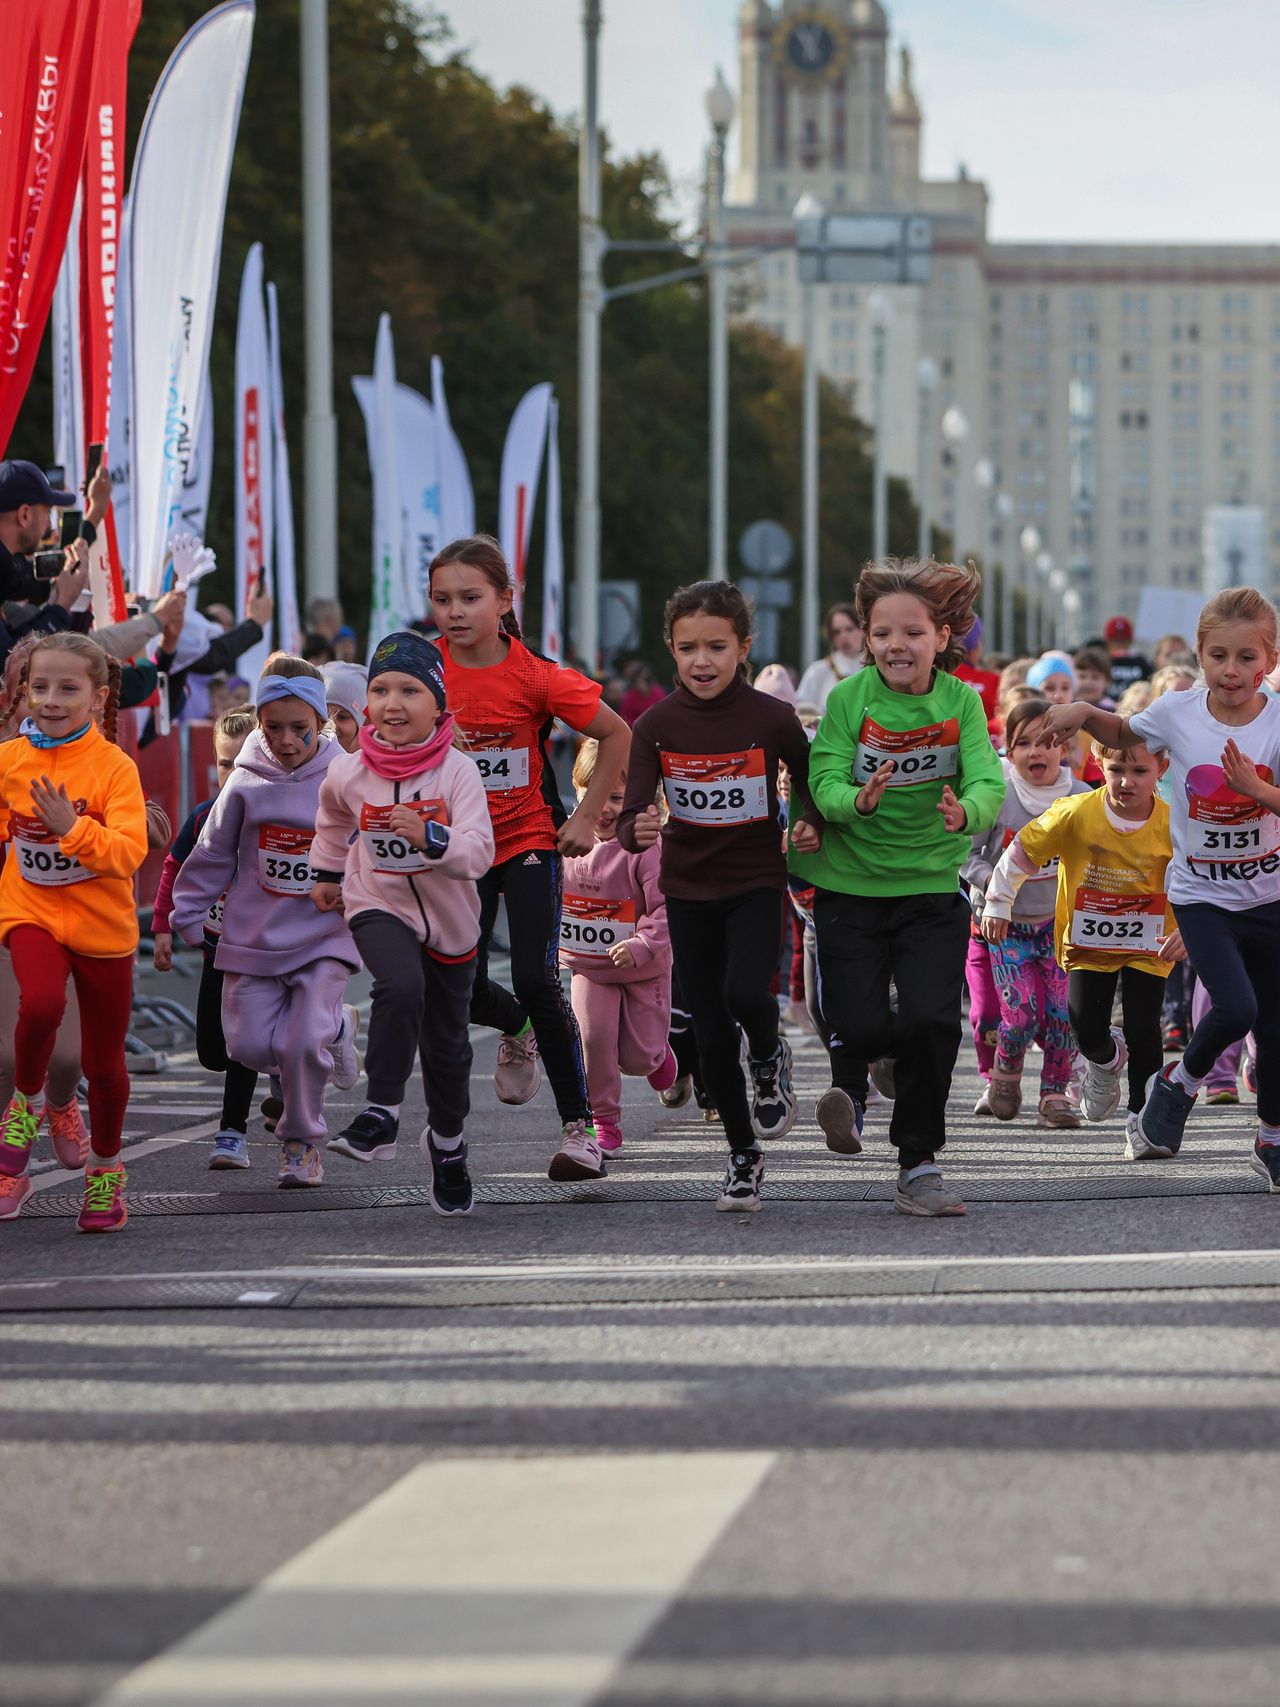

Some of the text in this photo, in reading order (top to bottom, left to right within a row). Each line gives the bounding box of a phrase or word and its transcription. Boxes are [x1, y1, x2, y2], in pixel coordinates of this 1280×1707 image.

[862, 754, 937, 774] 3002
[675, 787, 745, 810] 3028
[1203, 828, 1260, 849] 3131
[561, 922, 616, 945] 3100
[1082, 919, 1144, 938] 3032
